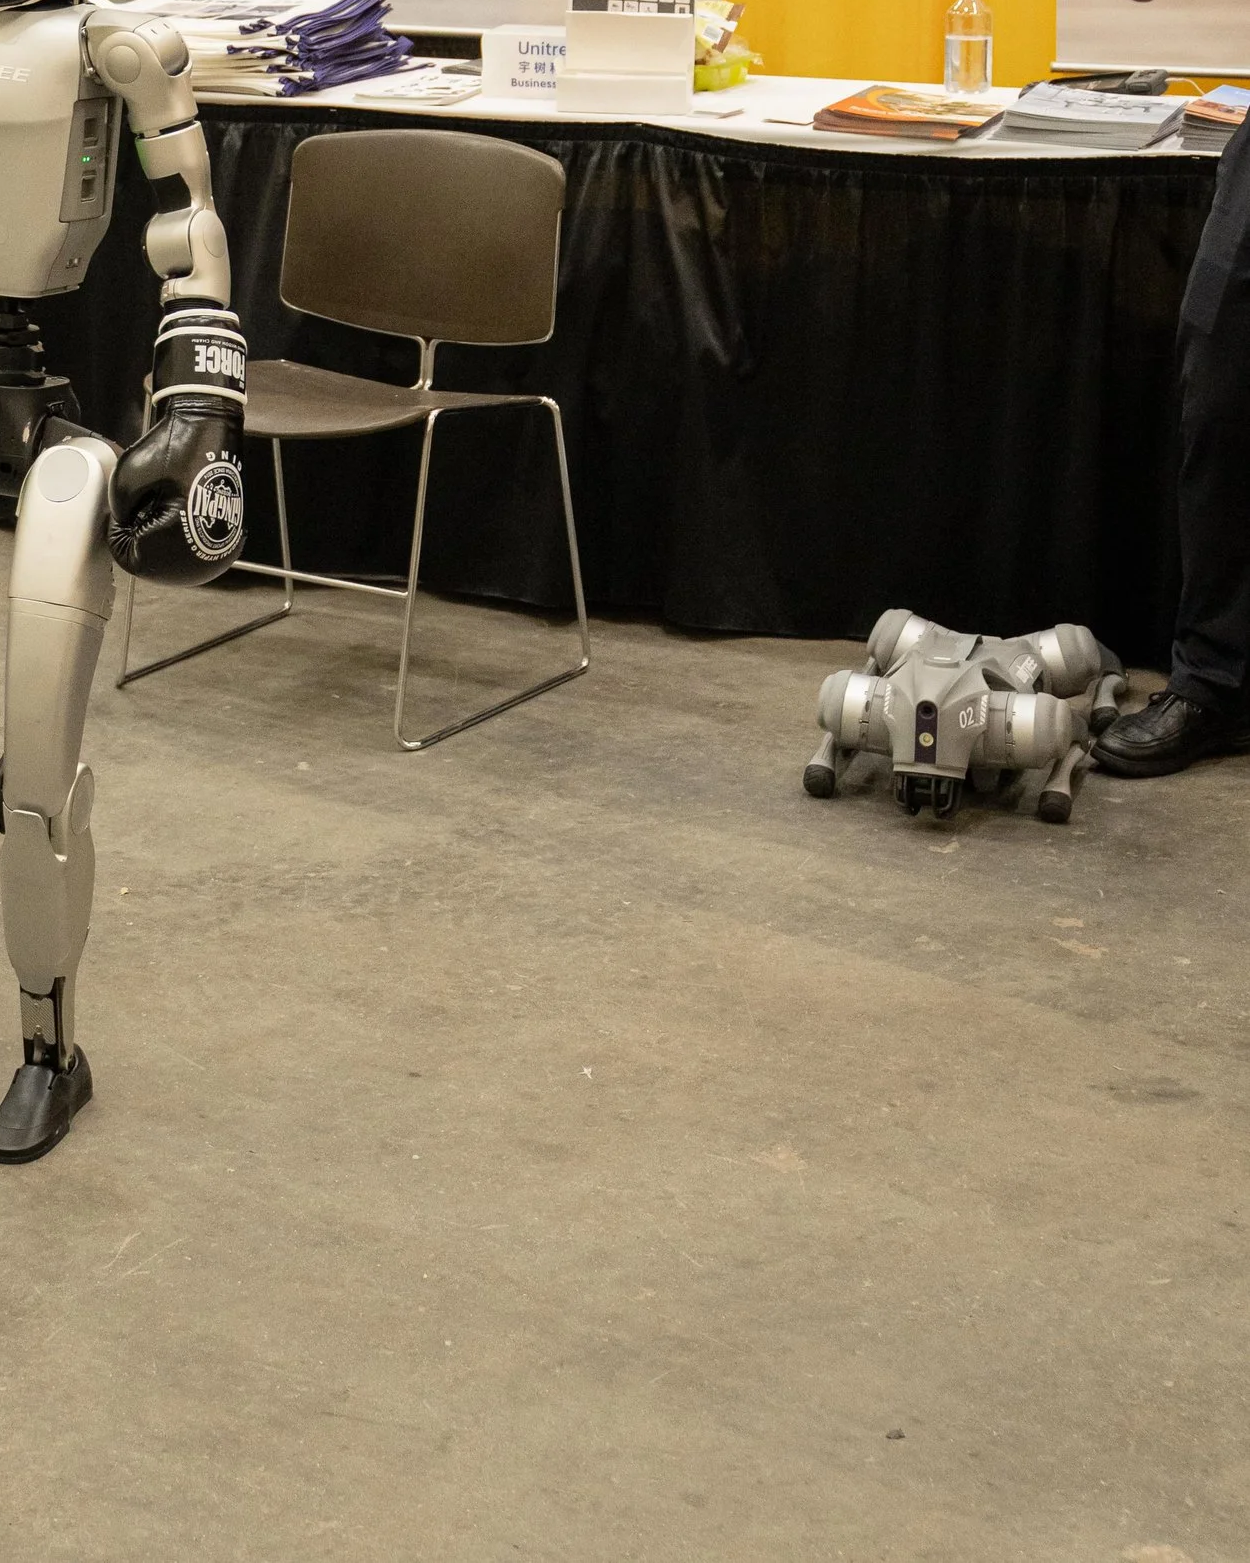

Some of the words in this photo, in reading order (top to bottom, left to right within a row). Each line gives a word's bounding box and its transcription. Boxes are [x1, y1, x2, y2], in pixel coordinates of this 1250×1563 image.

[518, 41, 566, 56] Unitre
[194, 344, 246, 382] FORCE
[179, 510, 194, 544] SERIES
[958, 706, 975, 730] 02
